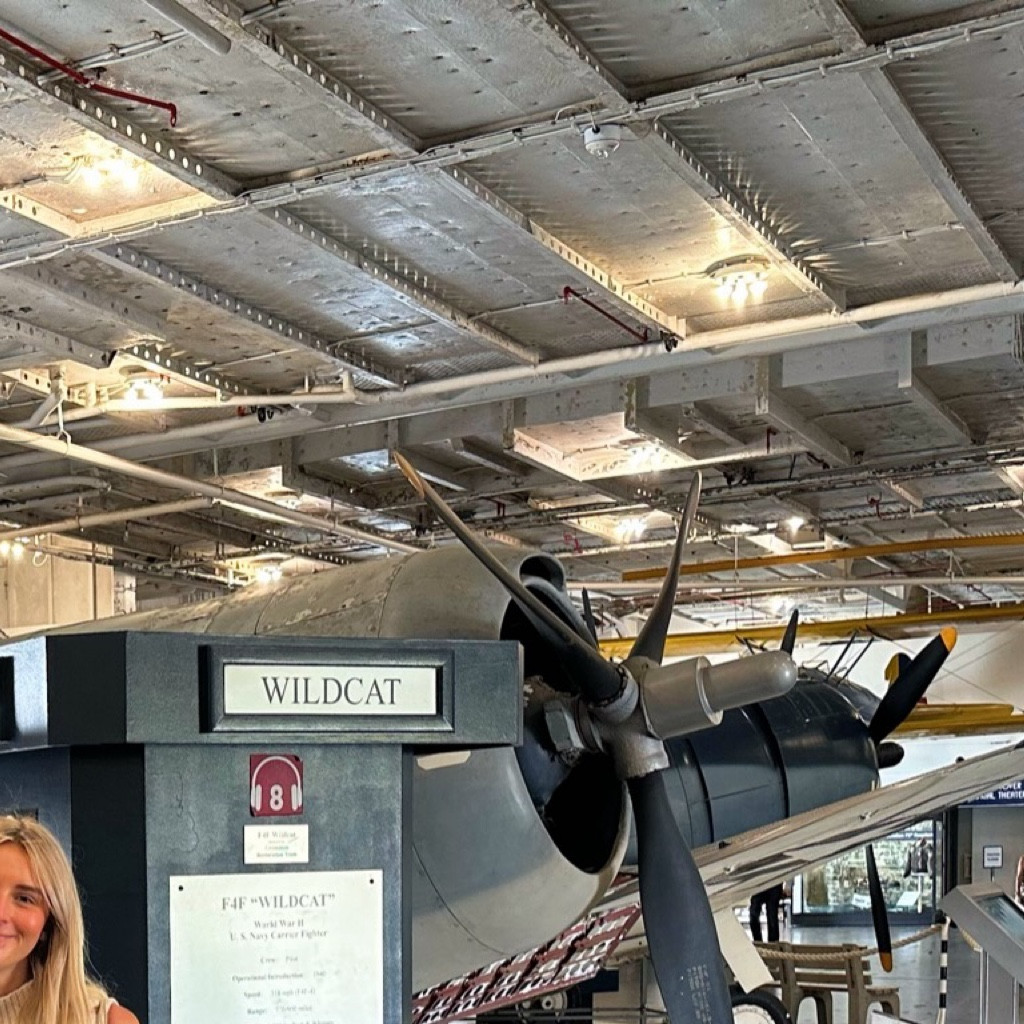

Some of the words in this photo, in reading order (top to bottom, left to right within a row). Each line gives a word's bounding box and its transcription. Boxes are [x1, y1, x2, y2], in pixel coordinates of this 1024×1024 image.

[261, 676, 402, 705] WILDCAT
[270, 784, 284, 811] 8
[222, 897, 247, 910] F4F
[279, 919, 295, 928] War
[250, 931, 268, 941] Navy
[271, 930, 299, 940] Carrier
[301, 929, 328, 939] Fighter
